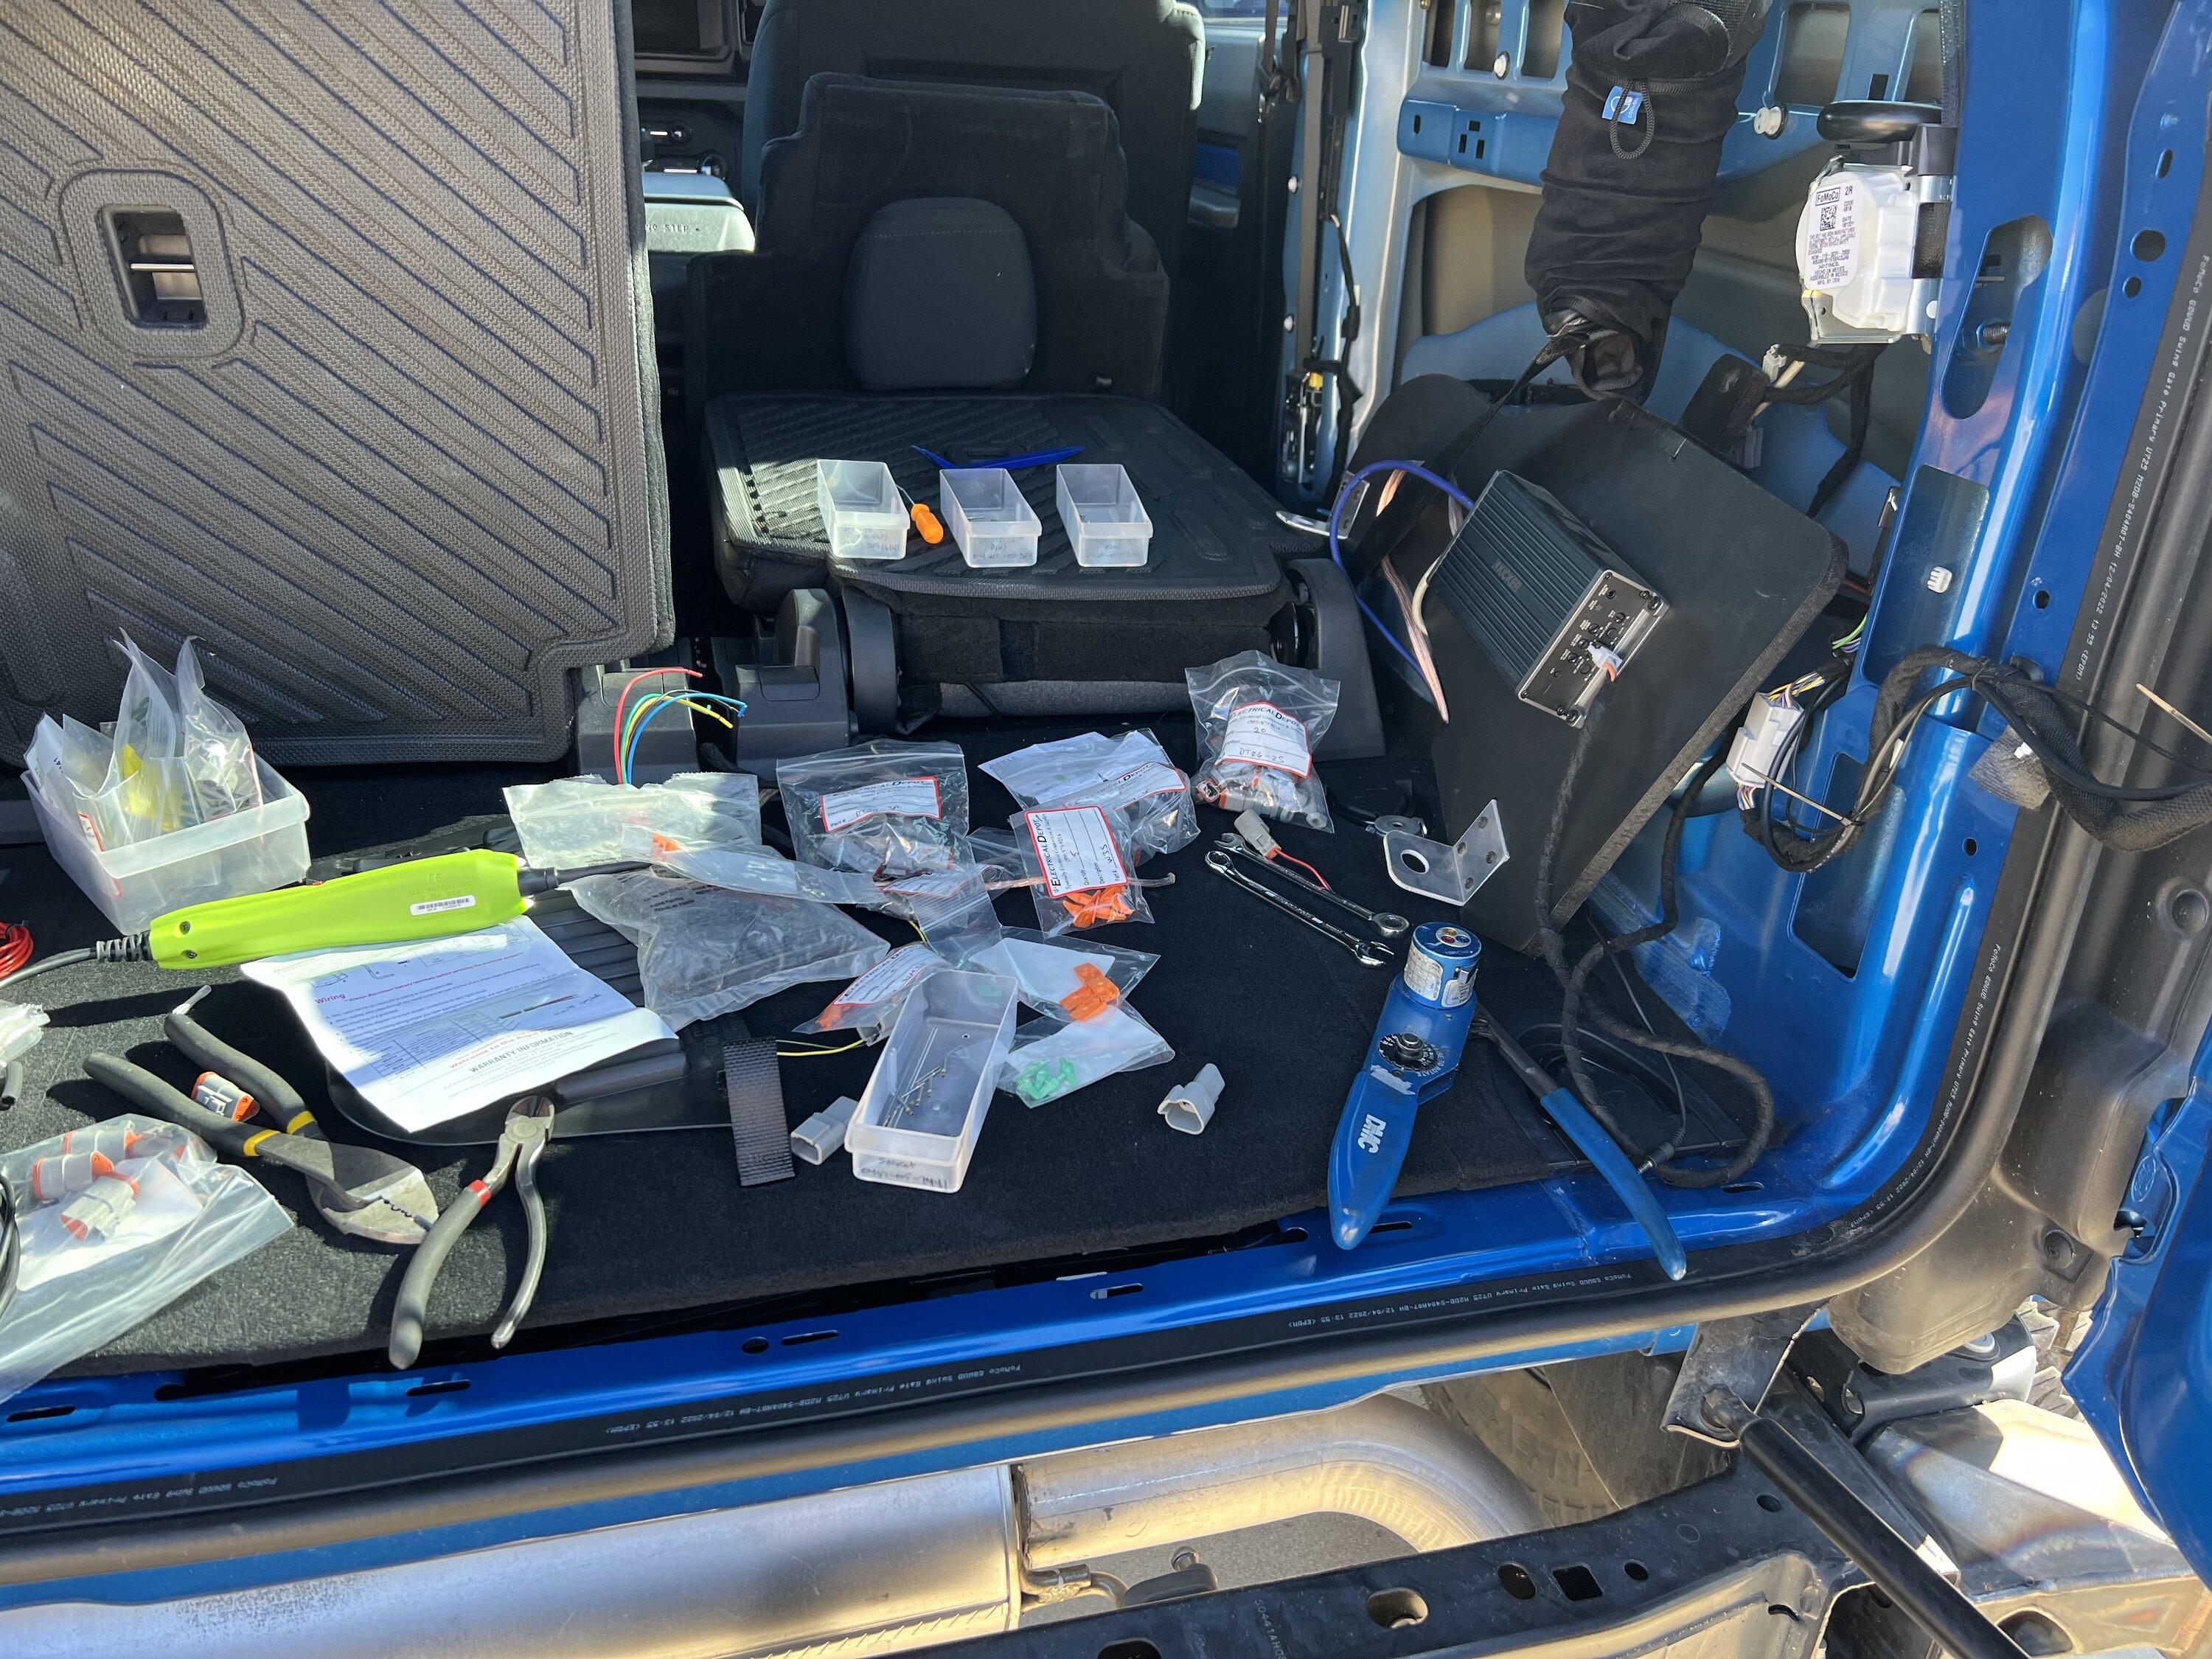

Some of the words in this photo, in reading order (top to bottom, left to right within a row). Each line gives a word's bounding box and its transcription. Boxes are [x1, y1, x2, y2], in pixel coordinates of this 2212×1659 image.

[1817, 190, 1840, 203] FoMoCo
[1845, 186, 1853, 195] 2R
[664, 223, 689, 233] STEP
[2192, 254, 2211, 294] FoMoCo
[2171, 335, 2186, 367] Swing
[2162, 371, 2176, 397] Gate
[2147, 399, 2167, 443] Primary
[2139, 446, 2153, 471] U725
[2095, 559, 2118, 615] 12/04/2022
[1276, 712, 1300, 727] DEPOT
[1034, 819, 1047, 844] DEPOT
[1041, 844, 1062, 888] ELECTRICAL
[315, 993, 345, 1005] Wiring
[1972, 1002, 1983, 1026] Swing
[1966, 1028, 1976, 1046] Gate
[470, 1049, 517, 1073] WARRANTY
[517, 1031, 574, 1053] INFORMATION
[1956, 1048, 1969, 1079] Primary
[1357, 1113, 1387, 1153] DMC
[1552, 1279, 1575, 1289] Swing
[1604, 1272, 1631, 1282] FoMoCo
[1472, 1292, 1492, 1301] U725
[1495, 1286, 1528, 1297] Primary
[1348, 1306, 1394, 1319] 12/04/2022
